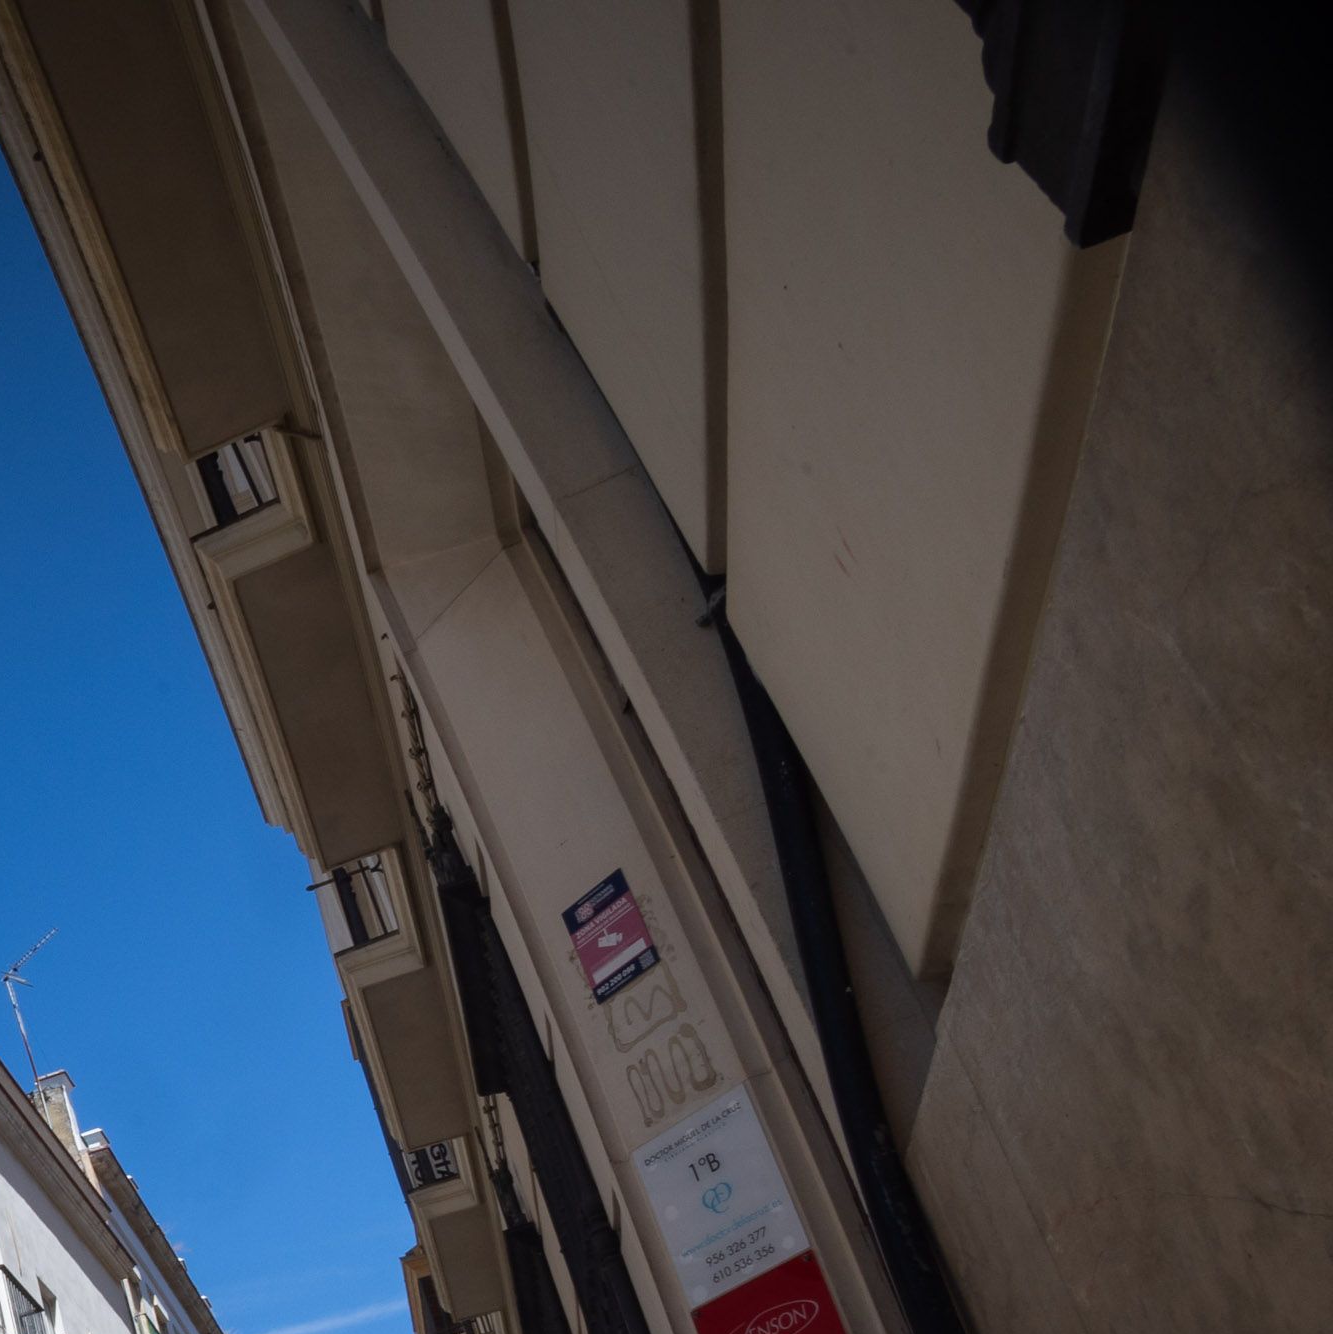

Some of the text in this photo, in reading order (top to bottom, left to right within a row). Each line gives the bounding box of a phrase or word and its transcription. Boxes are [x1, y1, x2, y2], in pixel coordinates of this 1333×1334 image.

[575, 920, 596, 940] ZONA
[595, 896, 629, 924] VIGILADA
[644, 1101, 742, 1166] DOCTOR MIGUEL DE LA CRUZ
[705, 1226, 766, 1267] 956 326 377
[712, 1243, 775, 1283] 610 536 356
